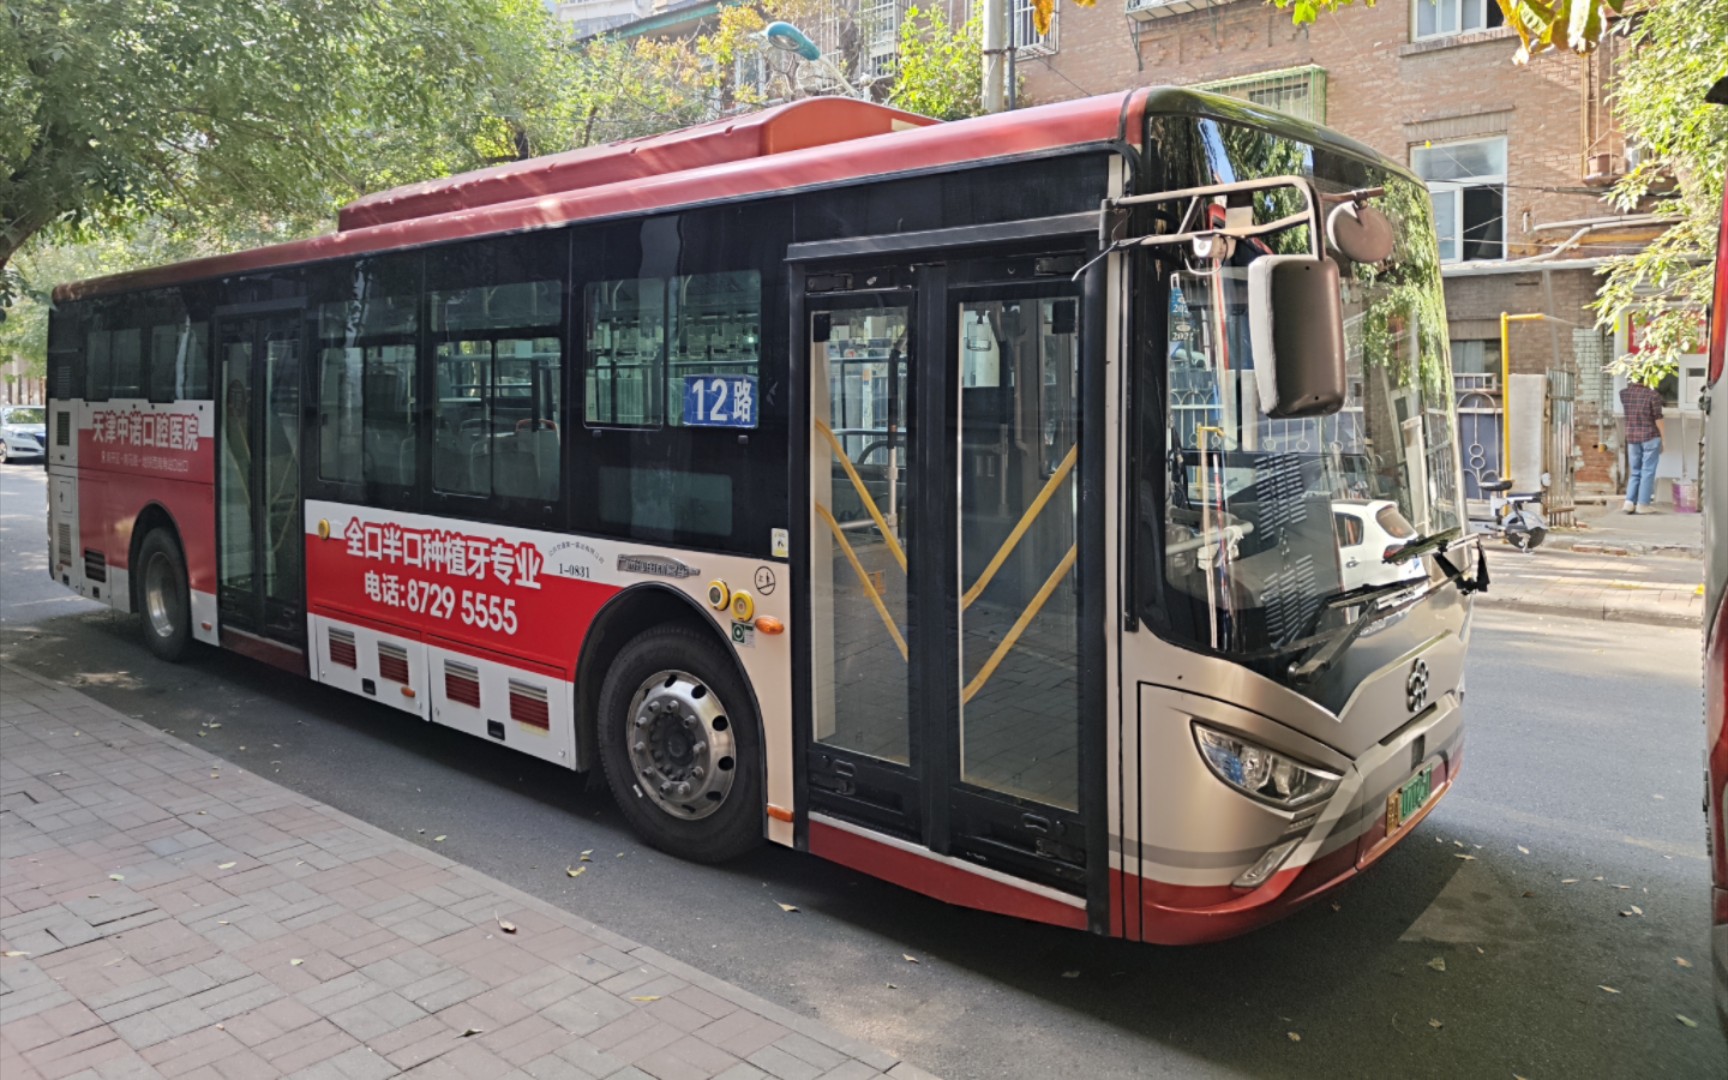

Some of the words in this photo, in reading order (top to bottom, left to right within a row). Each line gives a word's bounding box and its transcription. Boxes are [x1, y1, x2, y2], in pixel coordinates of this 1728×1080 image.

[692, 379, 752, 422] 12路
[93, 413, 198, 451] 天津中诺口腔医院
[346, 521, 542, 590] 全口半口种植牙专业
[559, 563, 590, 578] 1-0831
[461, 592, 518, 636] 5555
